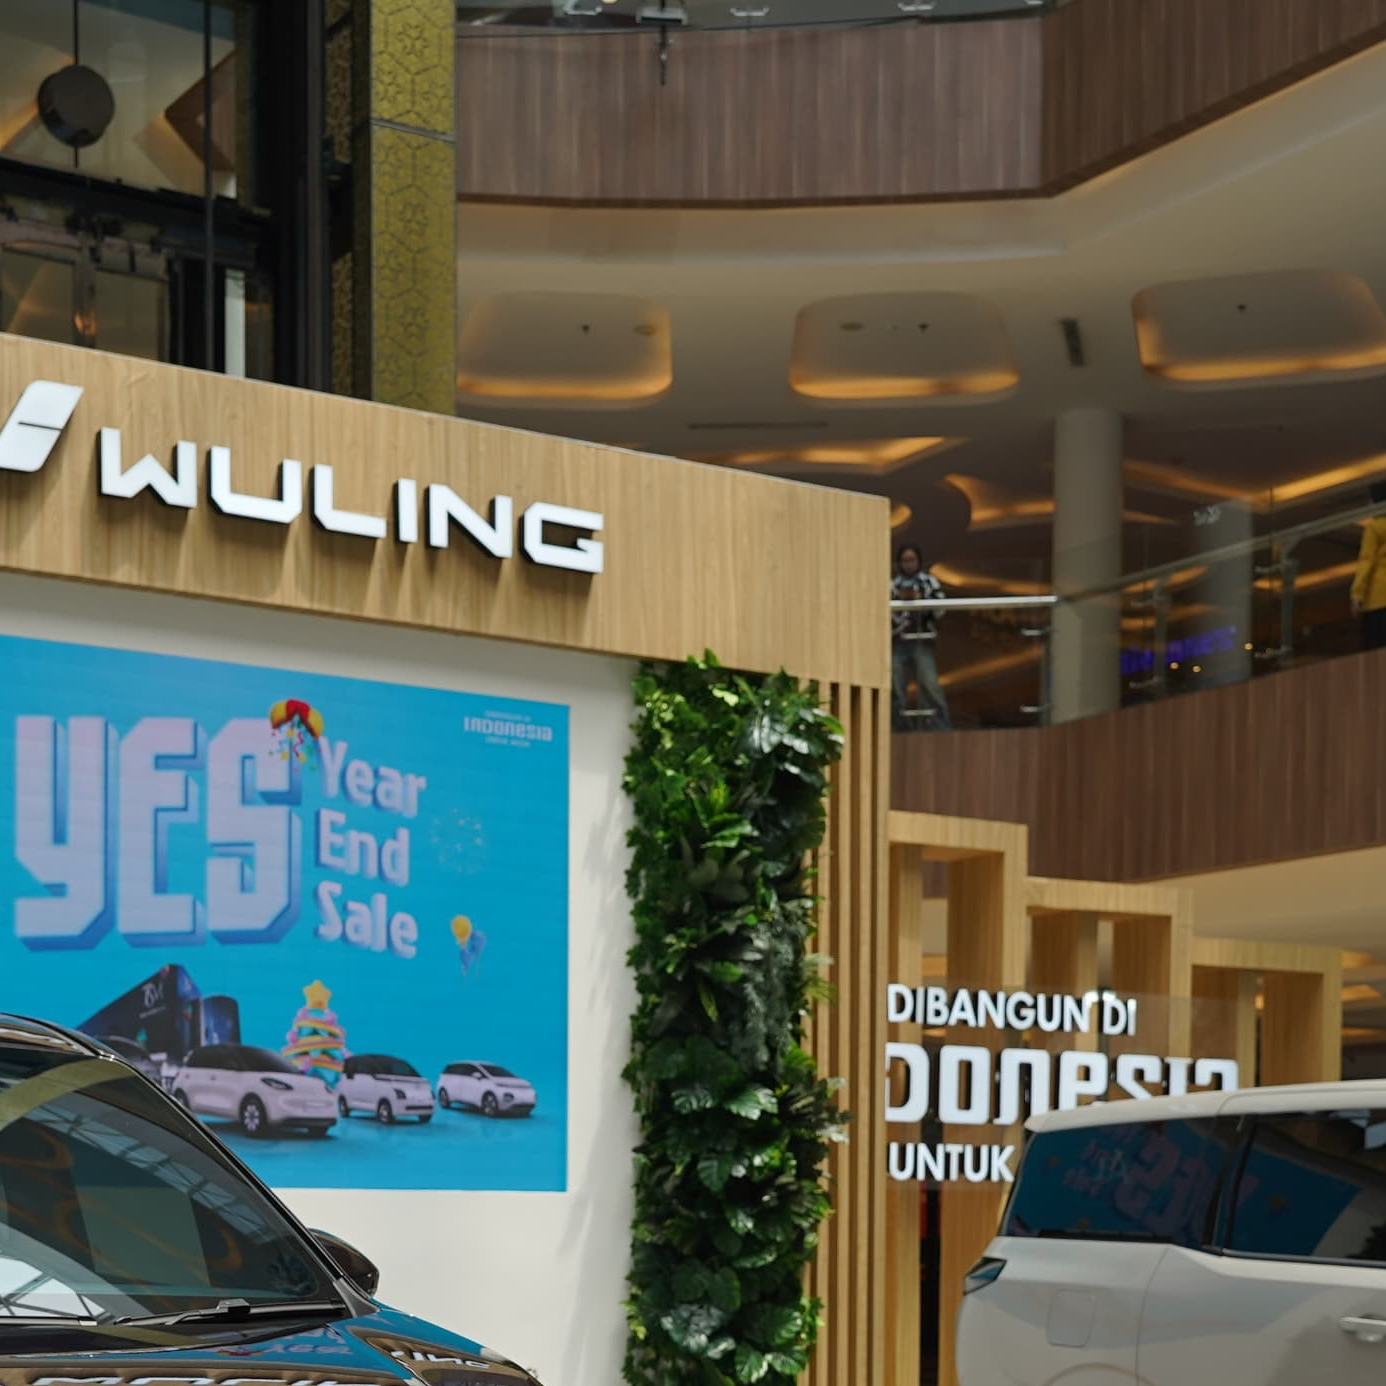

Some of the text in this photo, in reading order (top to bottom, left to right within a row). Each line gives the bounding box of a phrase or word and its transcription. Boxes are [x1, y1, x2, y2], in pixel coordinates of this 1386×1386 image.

[97, 426, 604, 574] WULING
[316, 734, 428, 818] Year
[316, 807, 411, 888] End
[315, 880, 420, 959] Sale
[887, 983, 1138, 1037] DIBANGUN DI
[888, 1142, 1015, 1183] UNTUK
